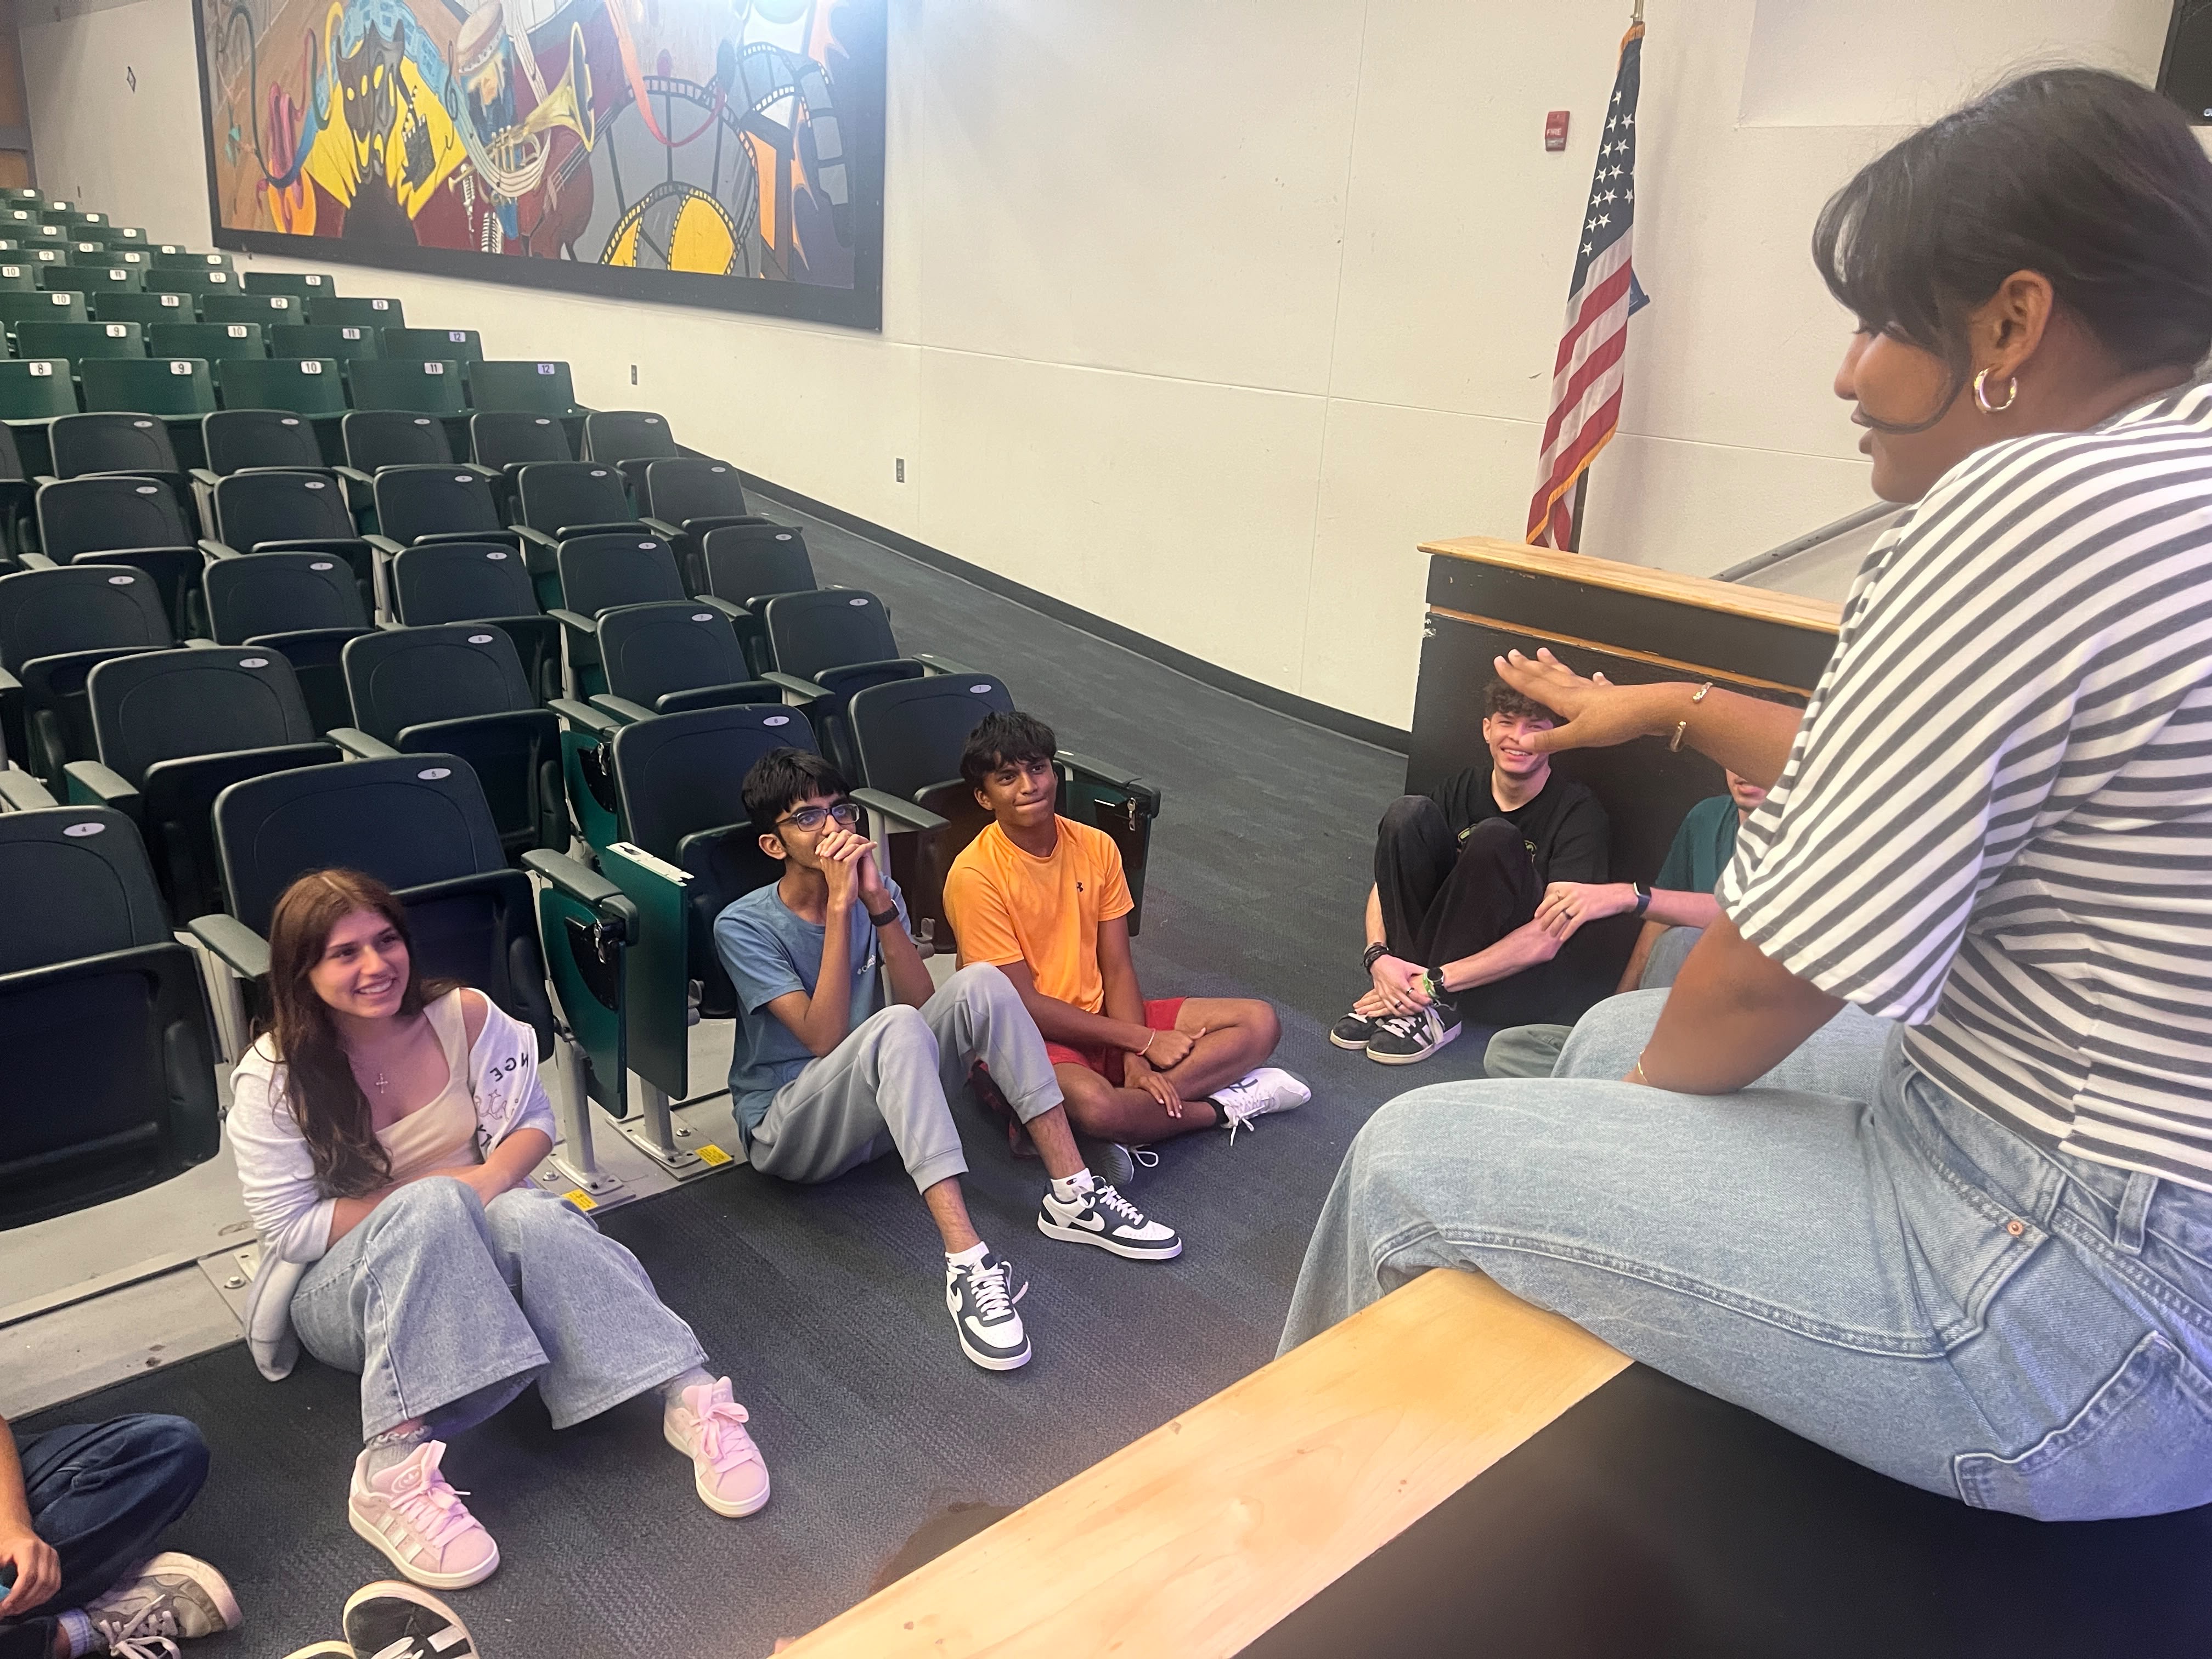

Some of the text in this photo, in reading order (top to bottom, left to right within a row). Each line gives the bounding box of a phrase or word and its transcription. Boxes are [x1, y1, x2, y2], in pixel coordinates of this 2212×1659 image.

[1546, 128, 1562, 136] FIRE
[57, 295, 66, 303] 10
[167, 297, 173, 305] 11
[275, 299, 283, 308] 12
[114, 326, 120, 336] 9
[233, 326, 242, 336] 10
[348, 329, 355, 337] 11
[454, 332, 461, 341] 12
[38, 363, 43, 375] 8
[178, 363, 184, 374] 9
[306, 363, 317, 372] 10
[430, 364, 437, 373] 11
[542, 365, 550, 373] 12
